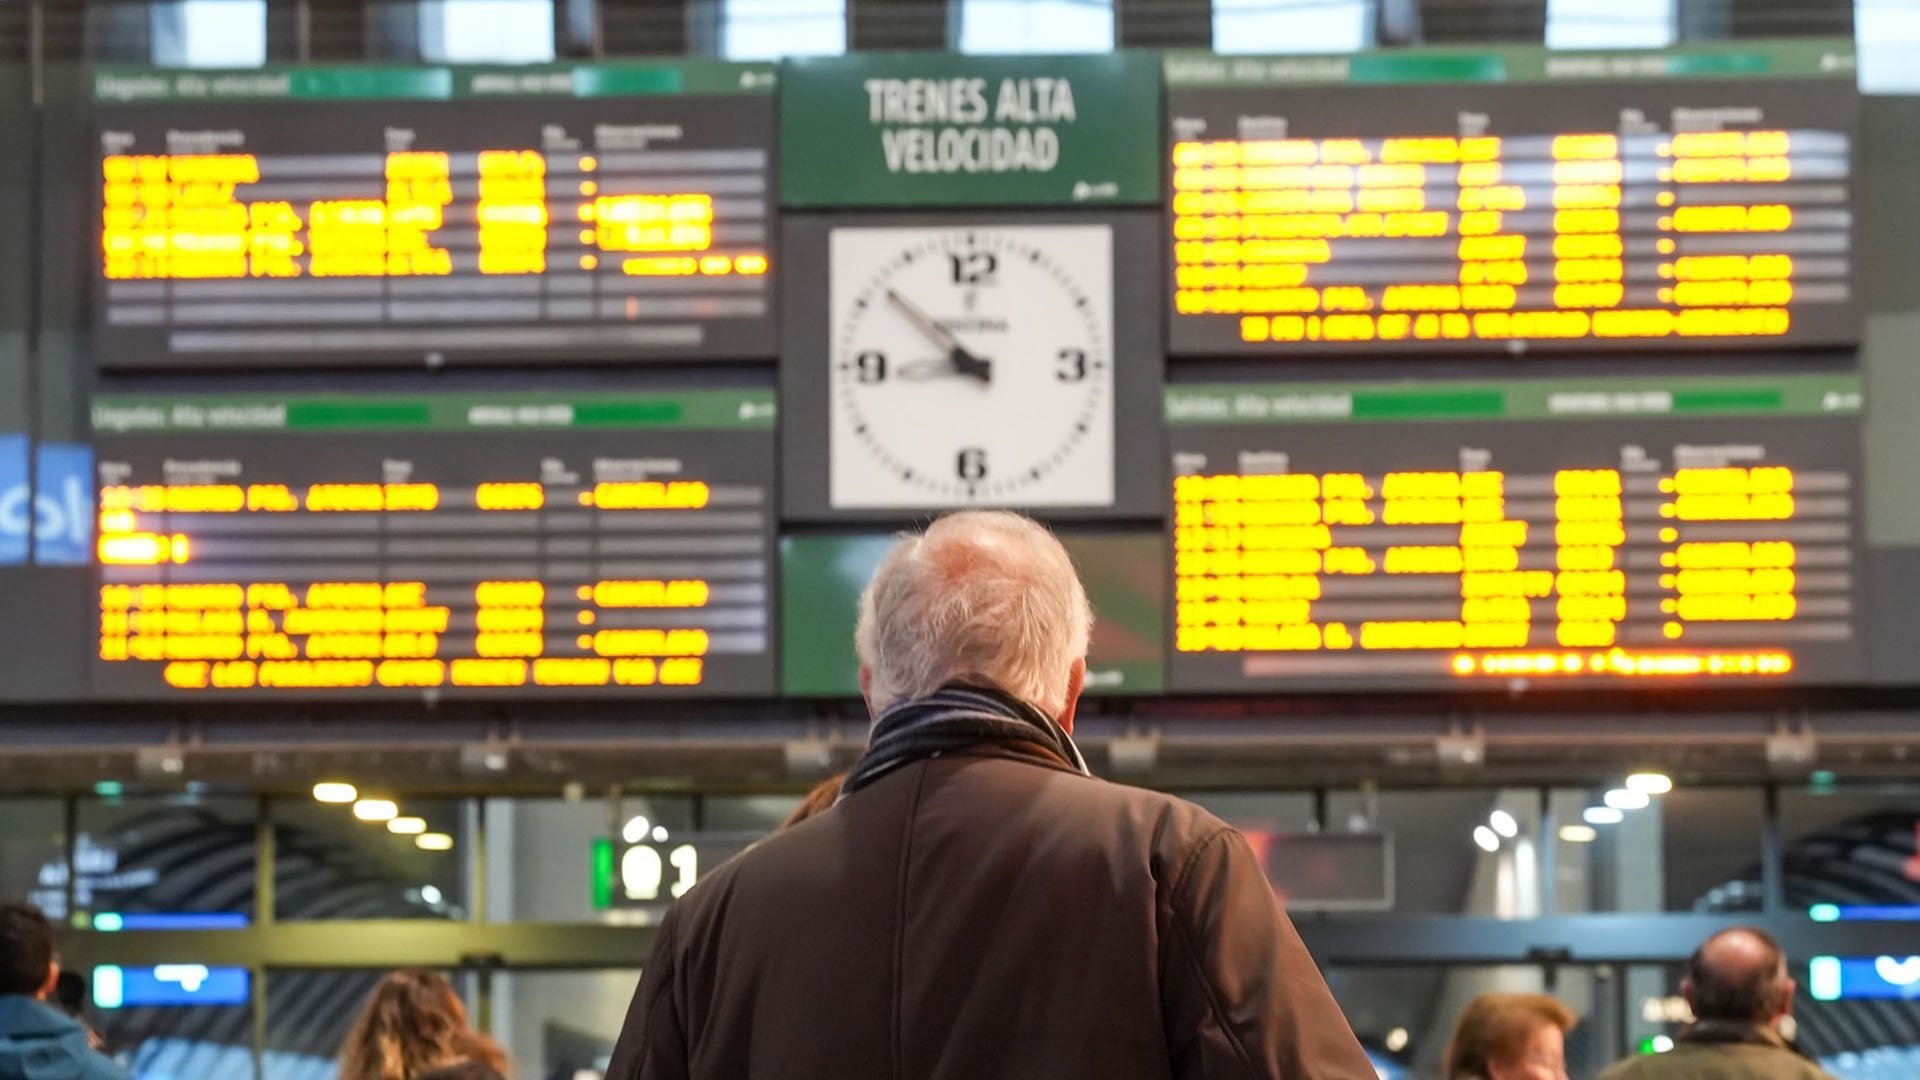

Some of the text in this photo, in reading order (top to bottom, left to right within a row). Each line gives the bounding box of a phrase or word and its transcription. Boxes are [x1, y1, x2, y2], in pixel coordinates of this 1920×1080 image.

[865, 77, 1076, 123] TRENES ALTA
[882, 127, 1059, 172] VELOCIDAD
[948, 251, 998, 284] 12
[857, 350, 886, 383] 9
[1056, 348, 1086, 382] 3
[956, 448, 988, 480] 6
